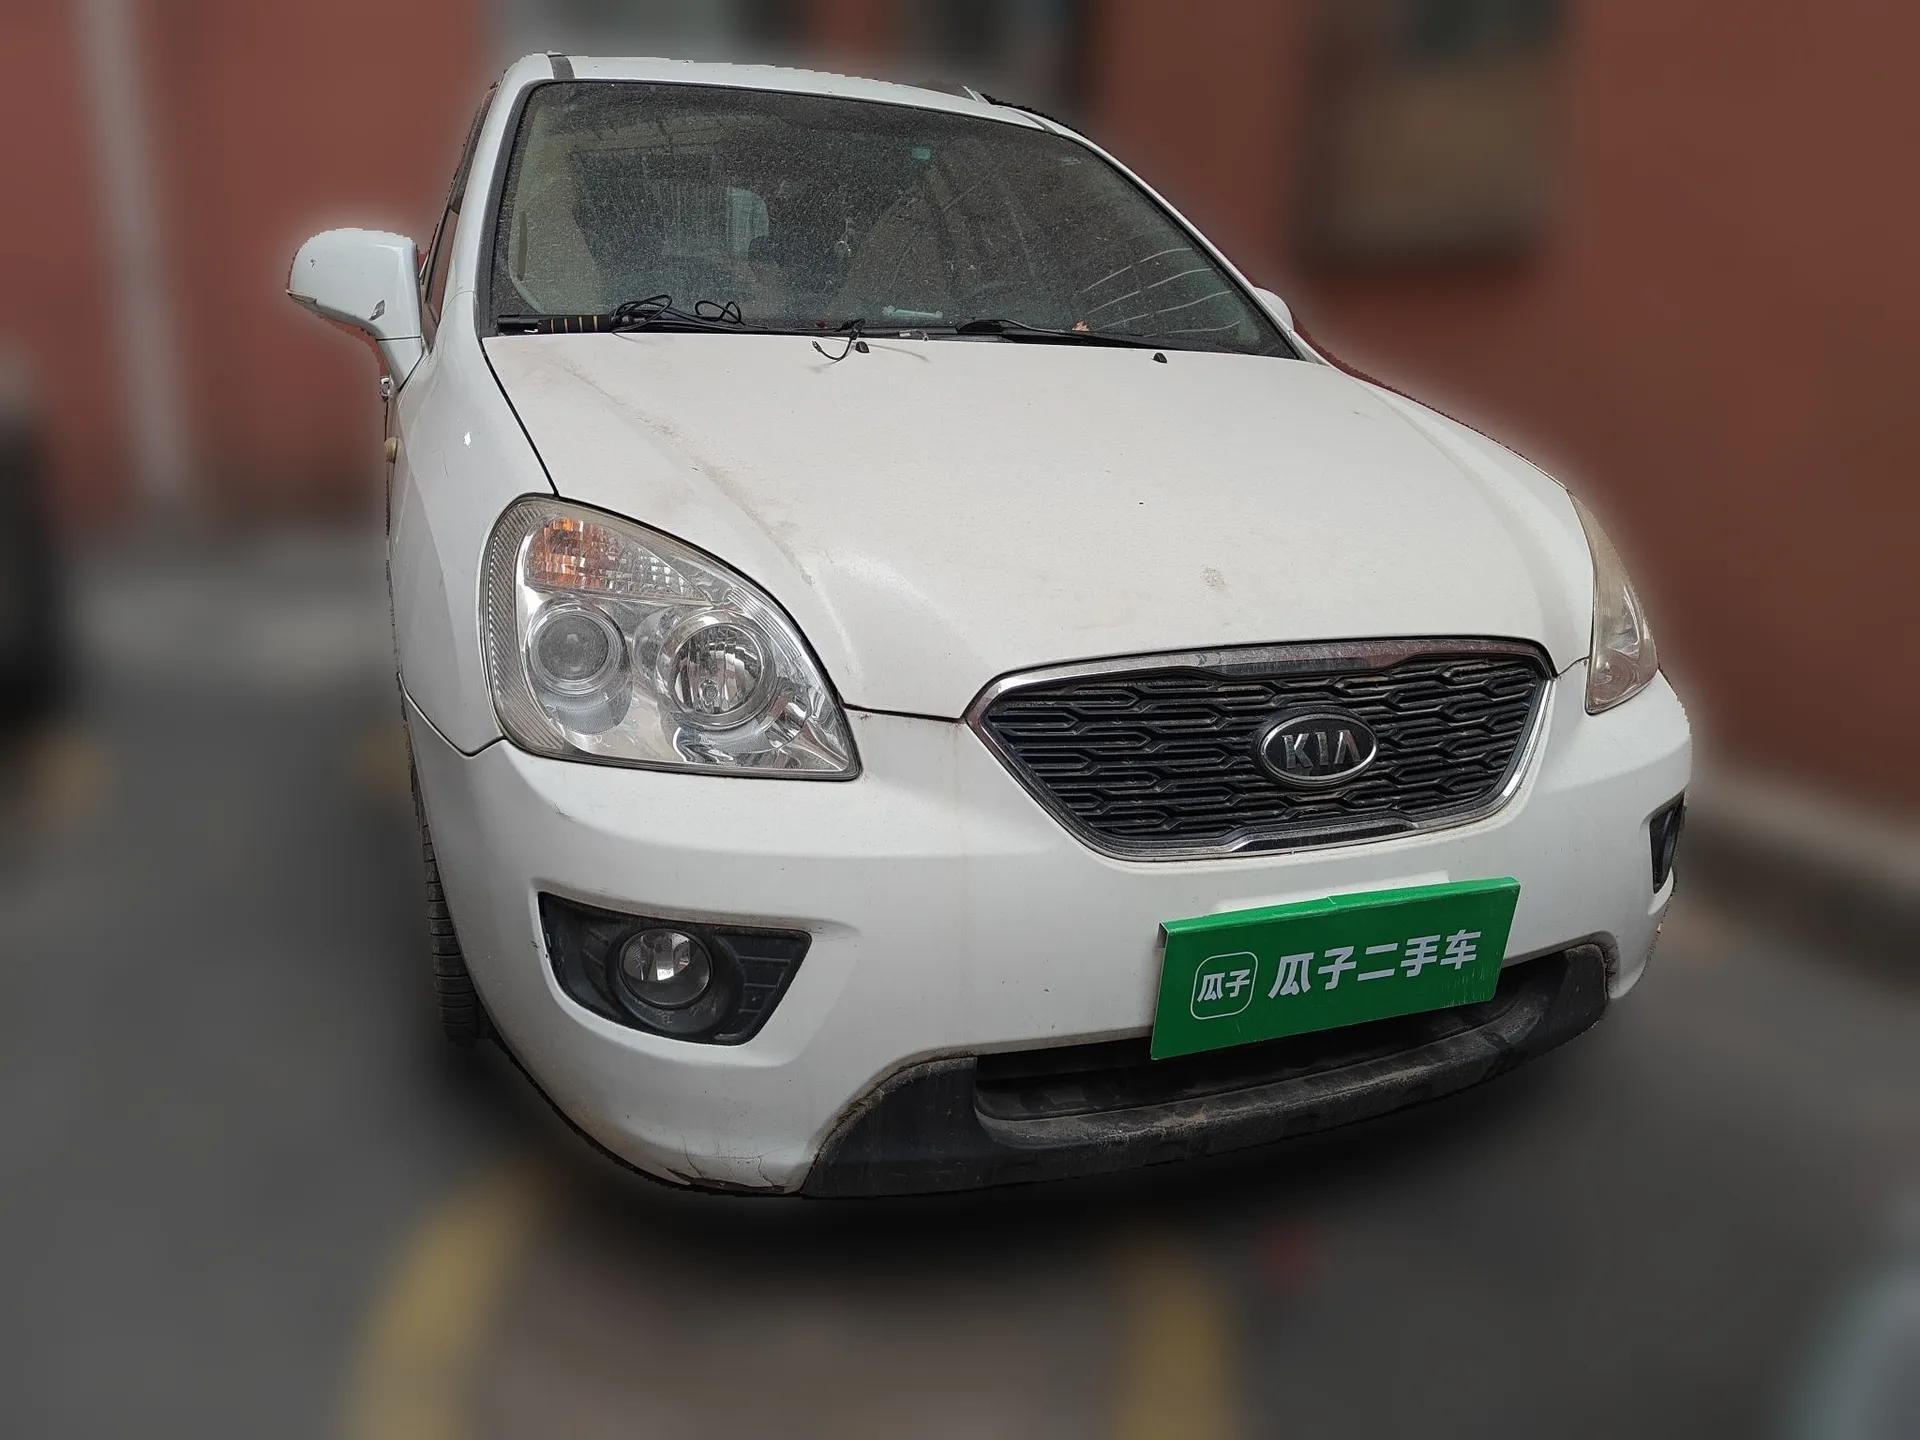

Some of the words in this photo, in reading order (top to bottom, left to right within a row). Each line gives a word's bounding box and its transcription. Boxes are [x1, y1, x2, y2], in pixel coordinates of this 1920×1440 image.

[1282, 730, 1360, 769] KIA
[1268, 929, 1481, 999] 瓜子二手车
[1197, 969, 1250, 1002] 瓜子
